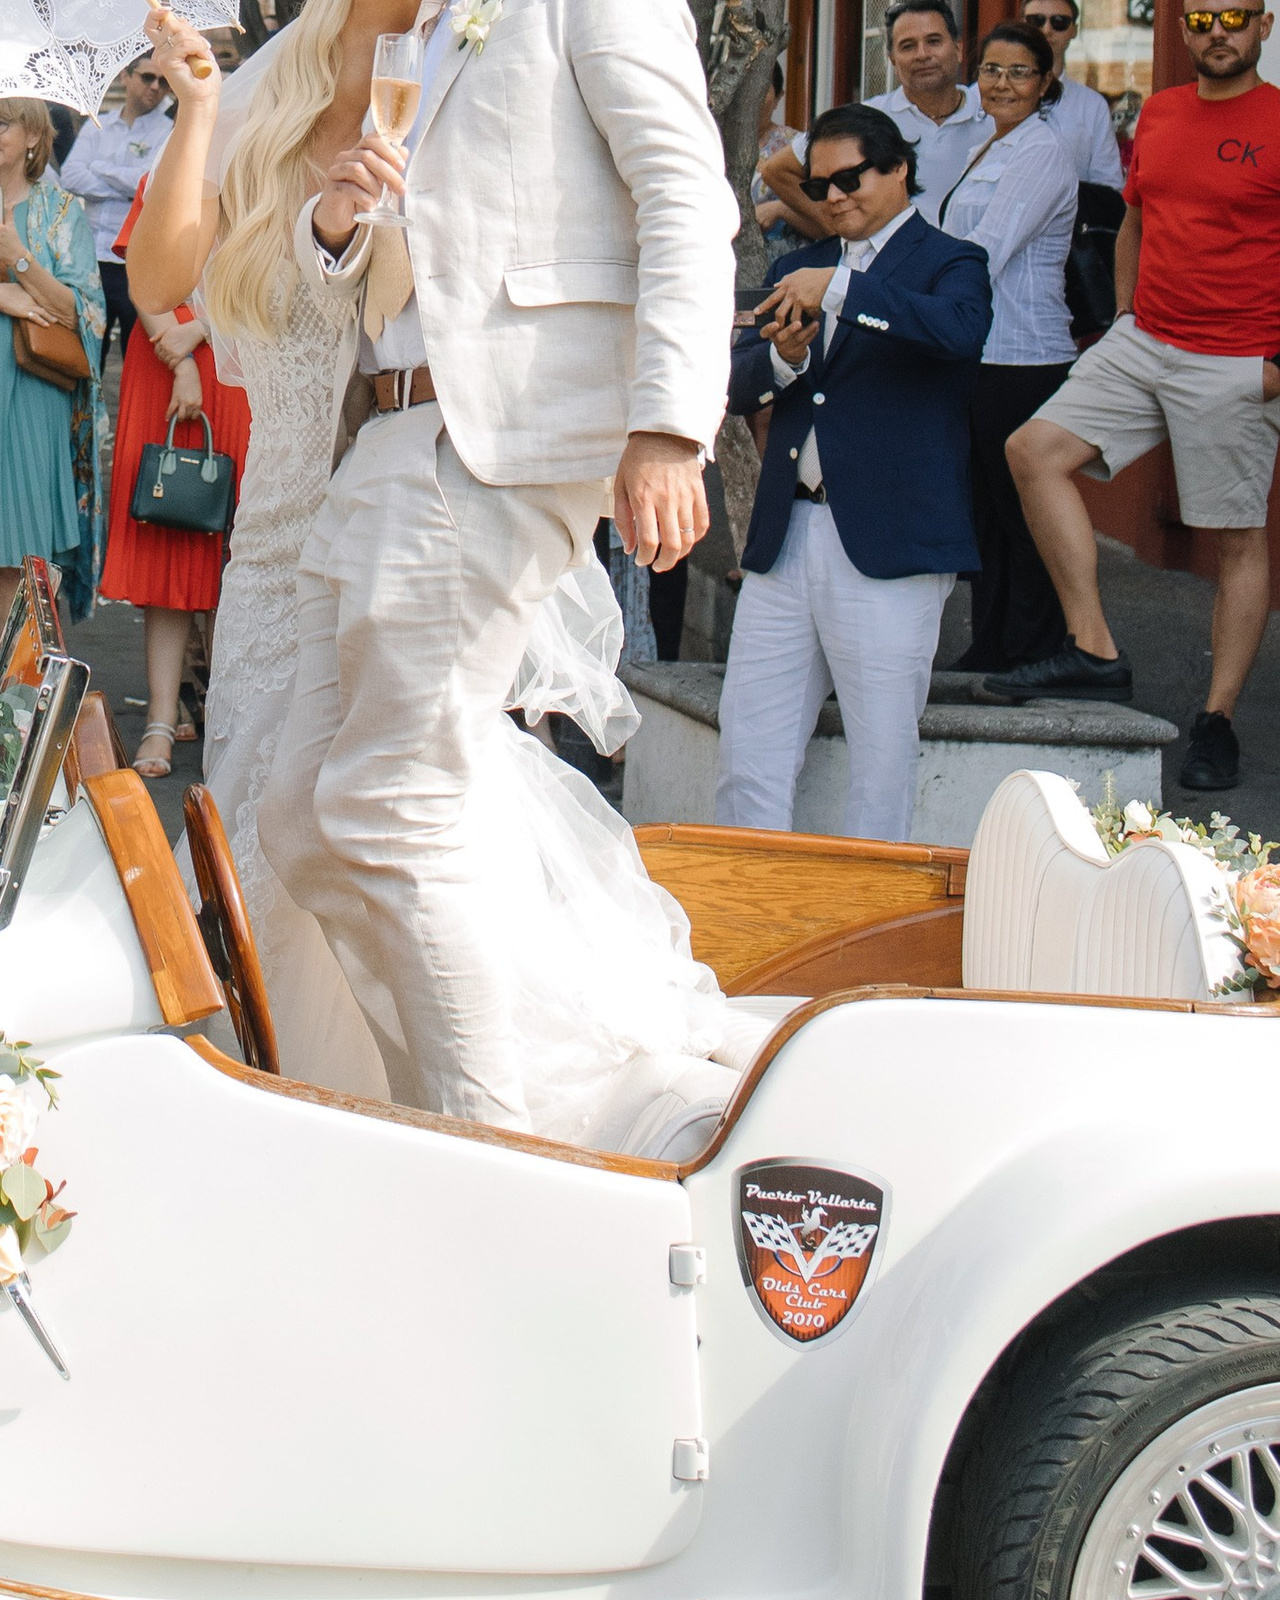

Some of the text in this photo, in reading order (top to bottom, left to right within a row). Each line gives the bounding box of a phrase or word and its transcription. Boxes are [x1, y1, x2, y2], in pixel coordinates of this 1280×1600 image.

[1217, 138, 1265, 168] CK
[745, 1183, 877, 1211] Puerto Vallarta
[762, 1277, 847, 1299] Olds Cars
[785, 1294, 827, 1309] Club
[782, 1311, 825, 1328] 2010
